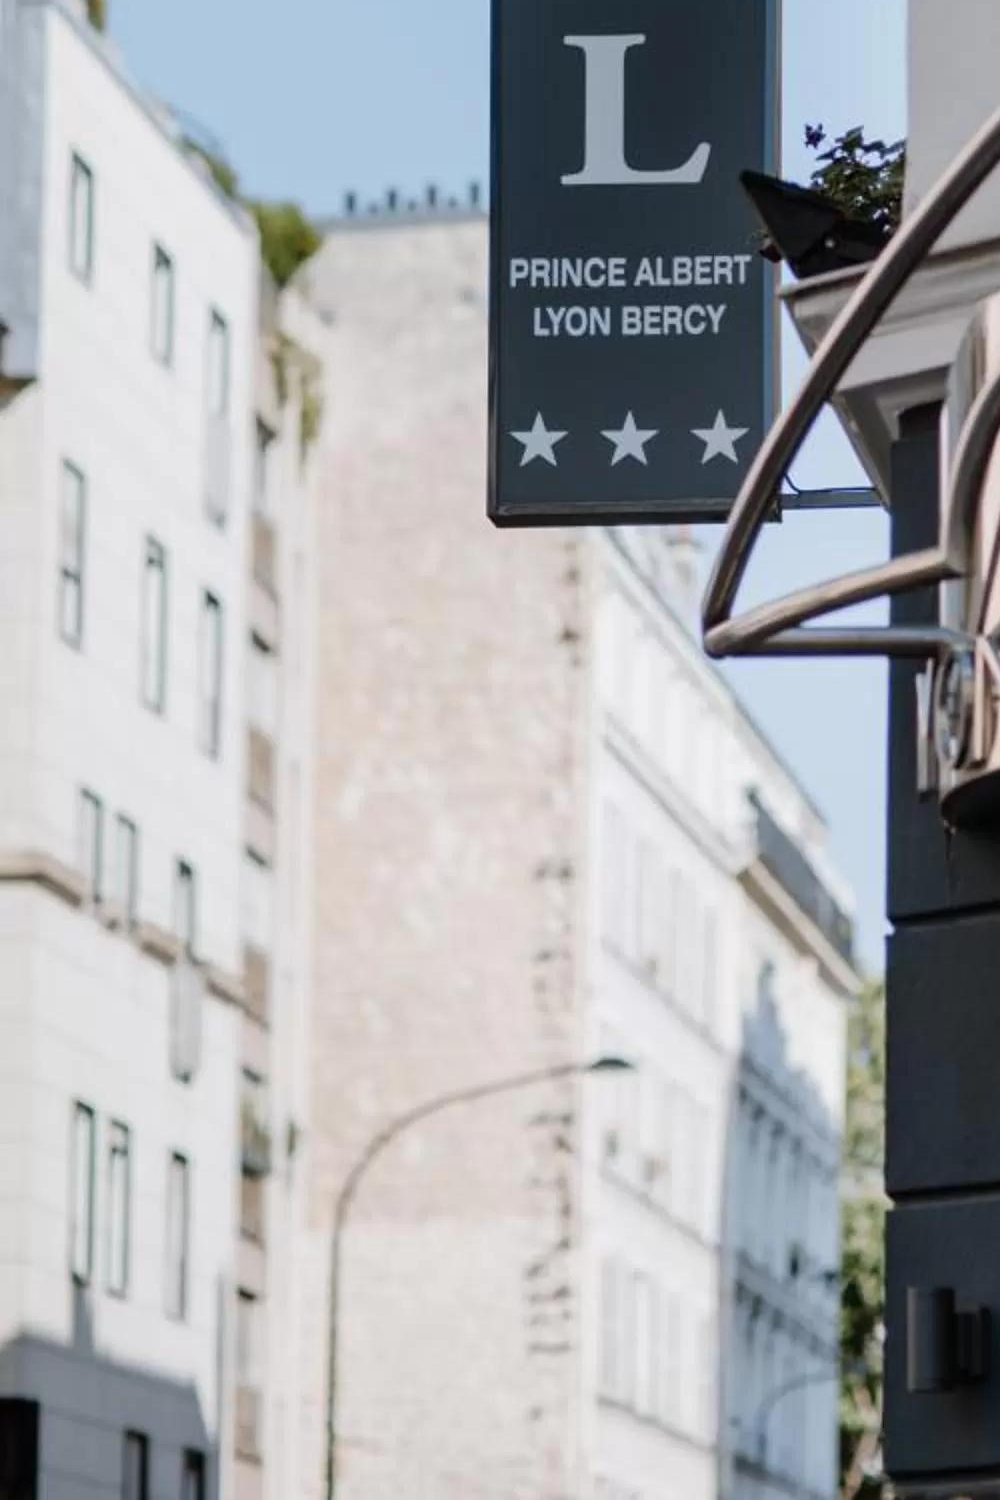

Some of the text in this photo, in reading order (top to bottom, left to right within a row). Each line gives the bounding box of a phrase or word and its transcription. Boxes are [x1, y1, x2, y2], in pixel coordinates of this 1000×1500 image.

[509, 254, 753, 288] PRINCE ALBERT
[532, 304, 727, 337] LYON BERCY
